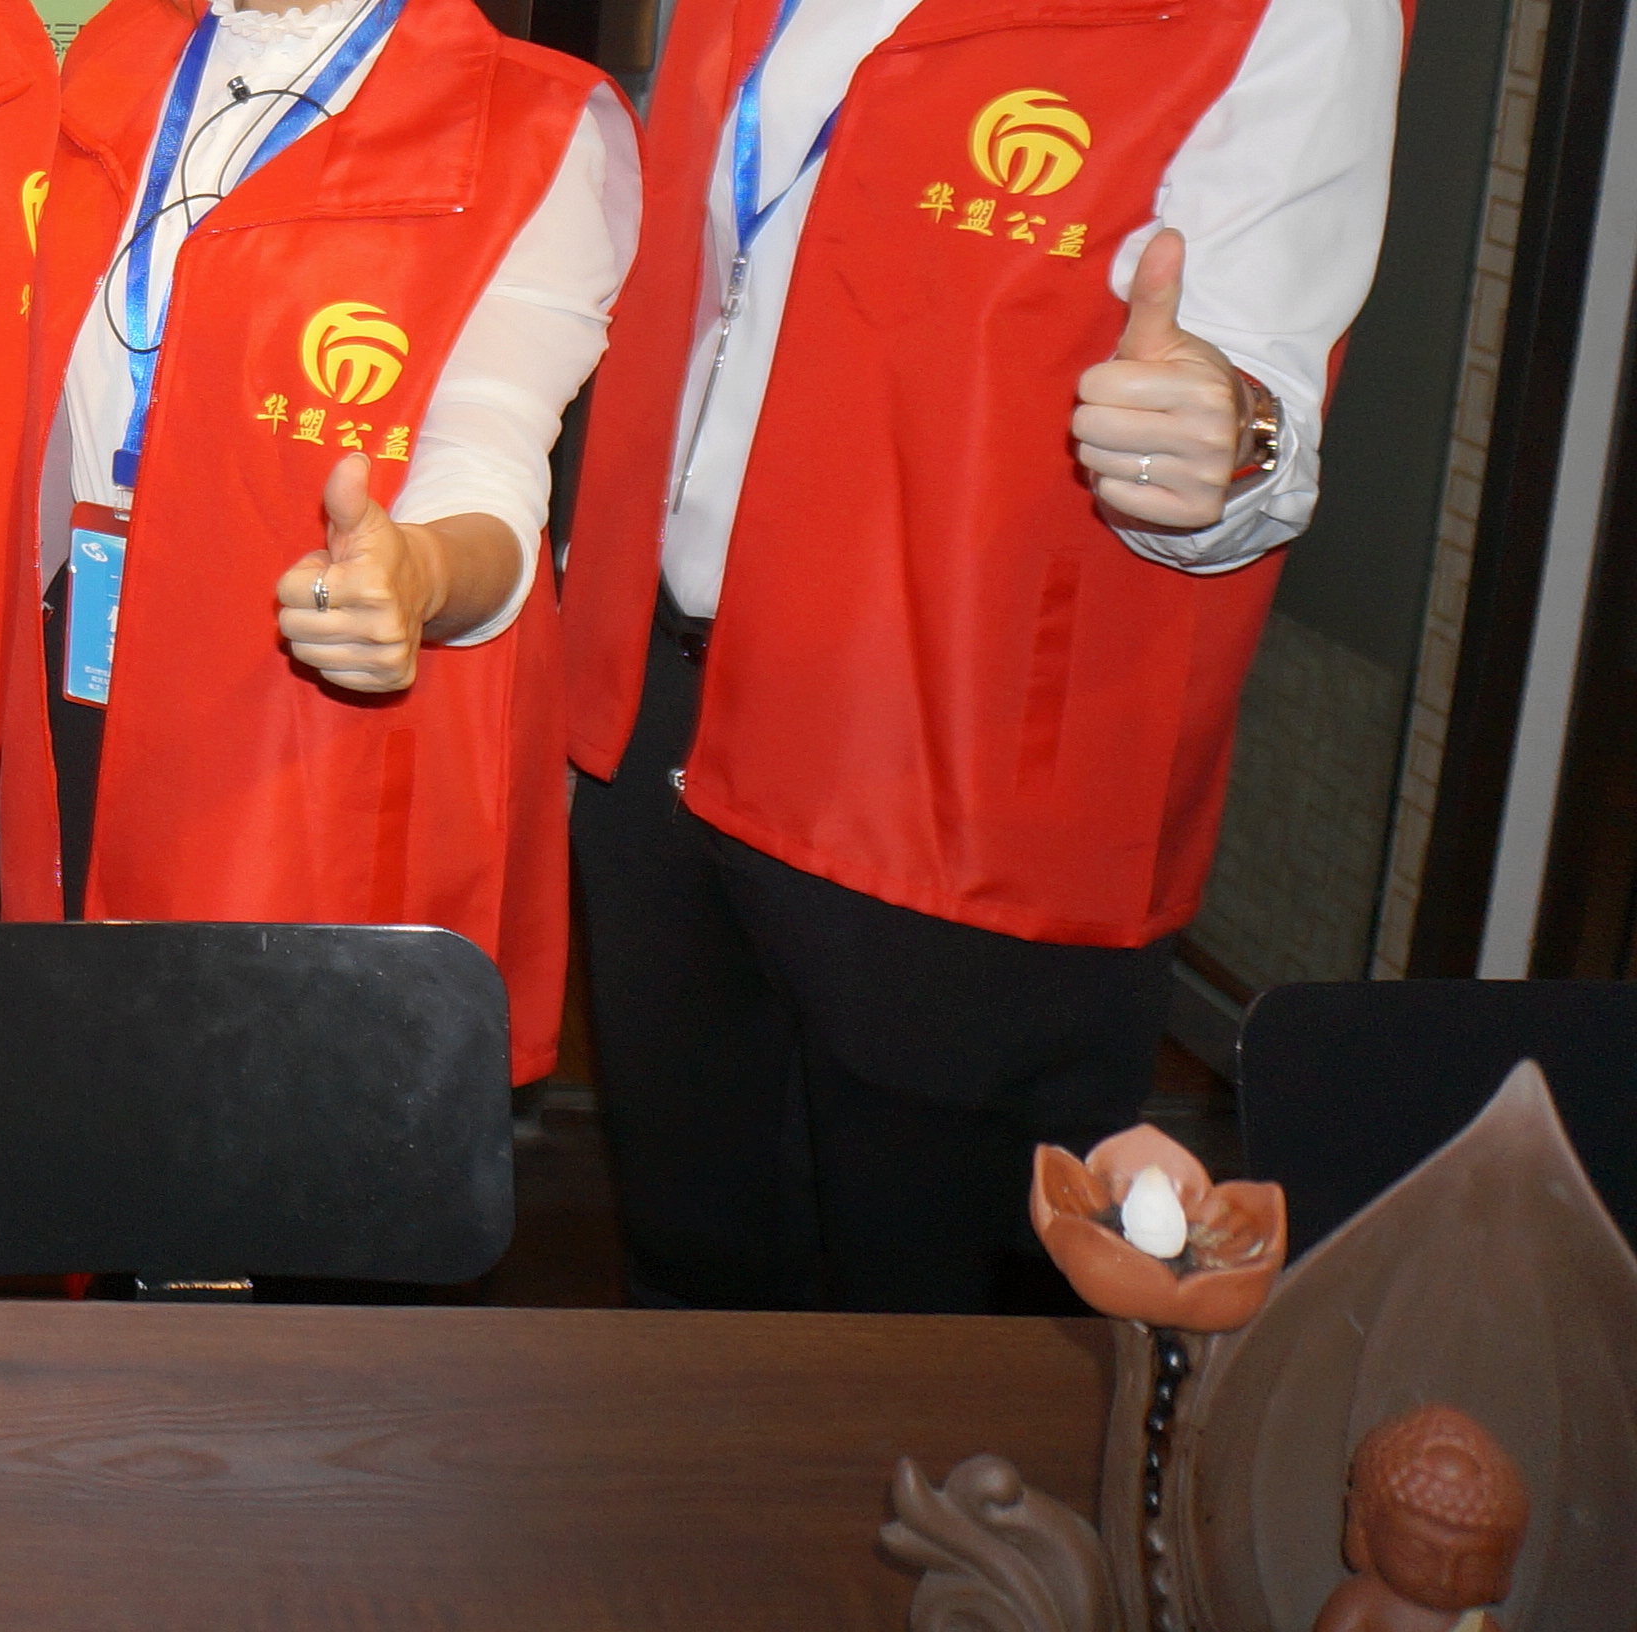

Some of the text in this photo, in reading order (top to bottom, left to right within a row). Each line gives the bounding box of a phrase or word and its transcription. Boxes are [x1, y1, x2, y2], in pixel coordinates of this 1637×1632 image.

[918, 182, 1088, 258] 华盟公益
[256, 393, 410, 463] 华盟公益
